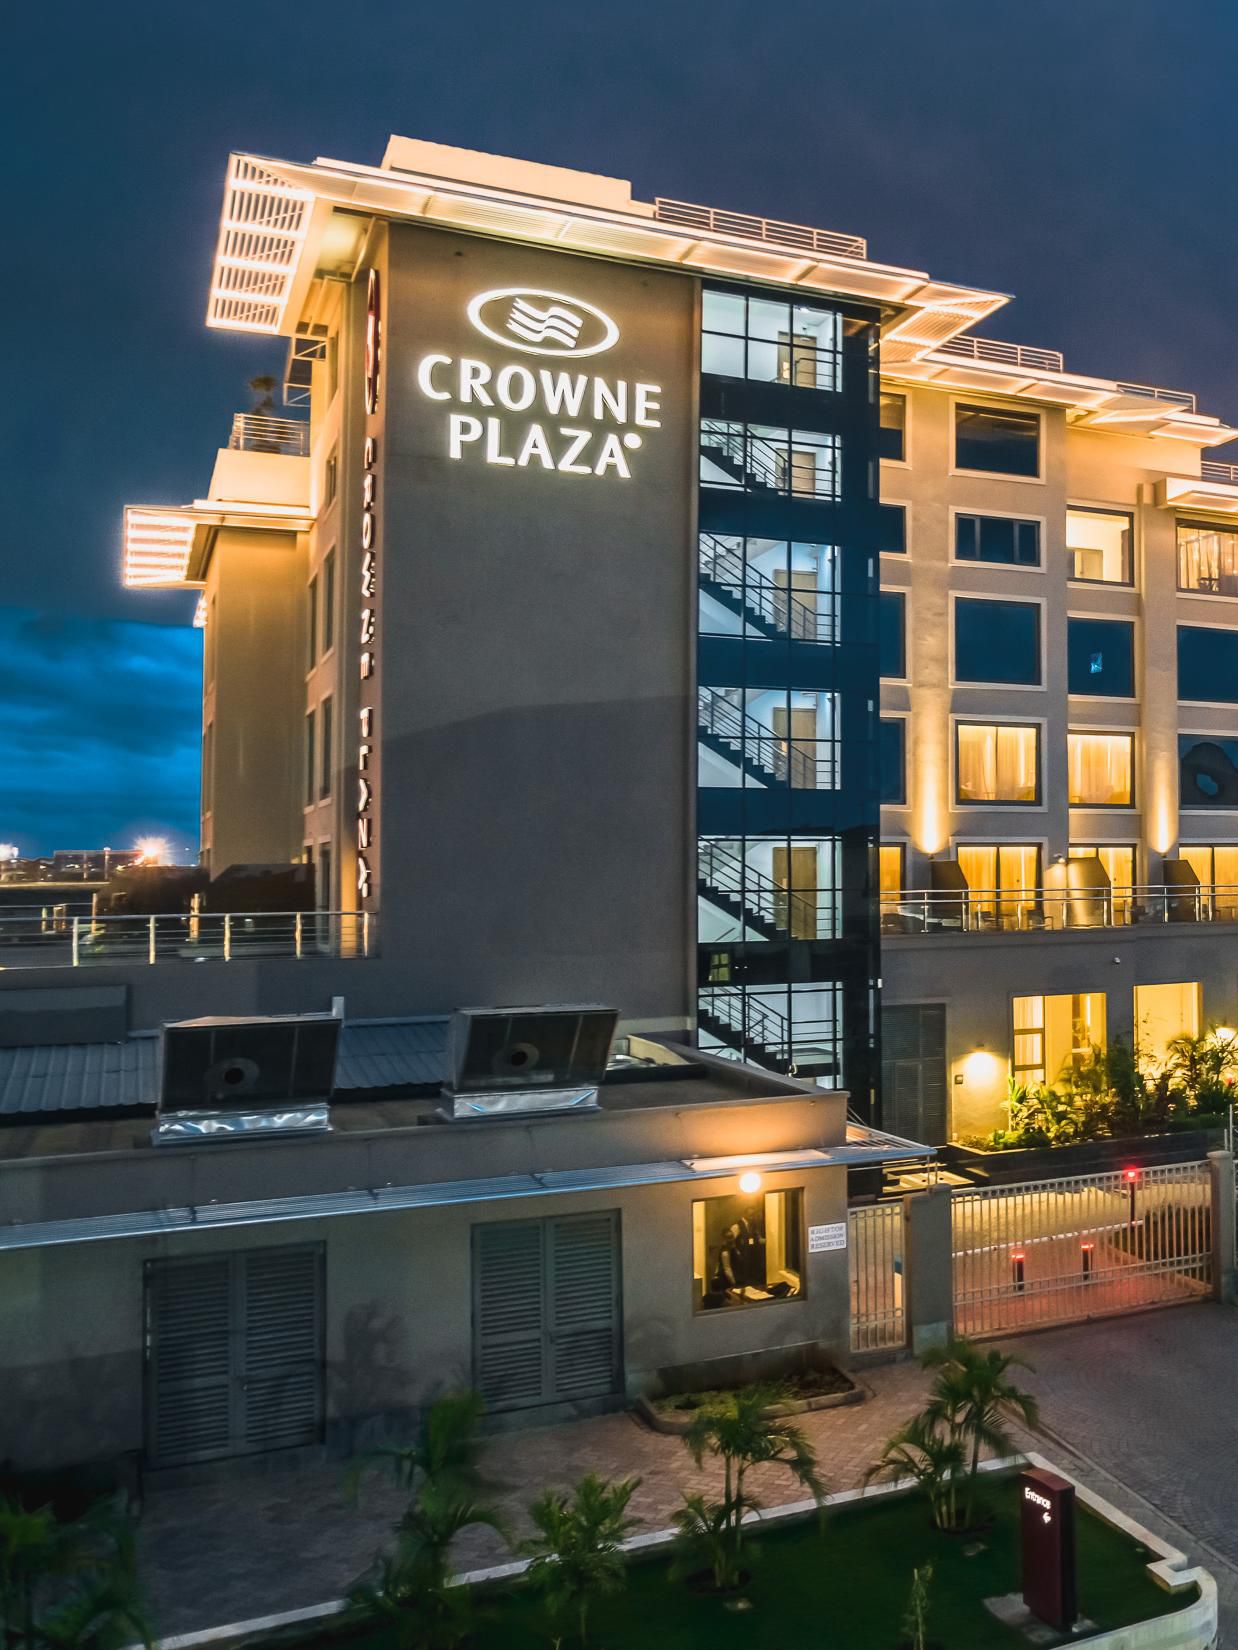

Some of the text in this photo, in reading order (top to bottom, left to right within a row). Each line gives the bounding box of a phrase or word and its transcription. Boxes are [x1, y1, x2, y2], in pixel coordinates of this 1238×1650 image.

[418, 354, 662, 428] CROWNE
[449, 414, 633, 479] PLAZA
[1024, 1486, 1052, 1510] Entrance
